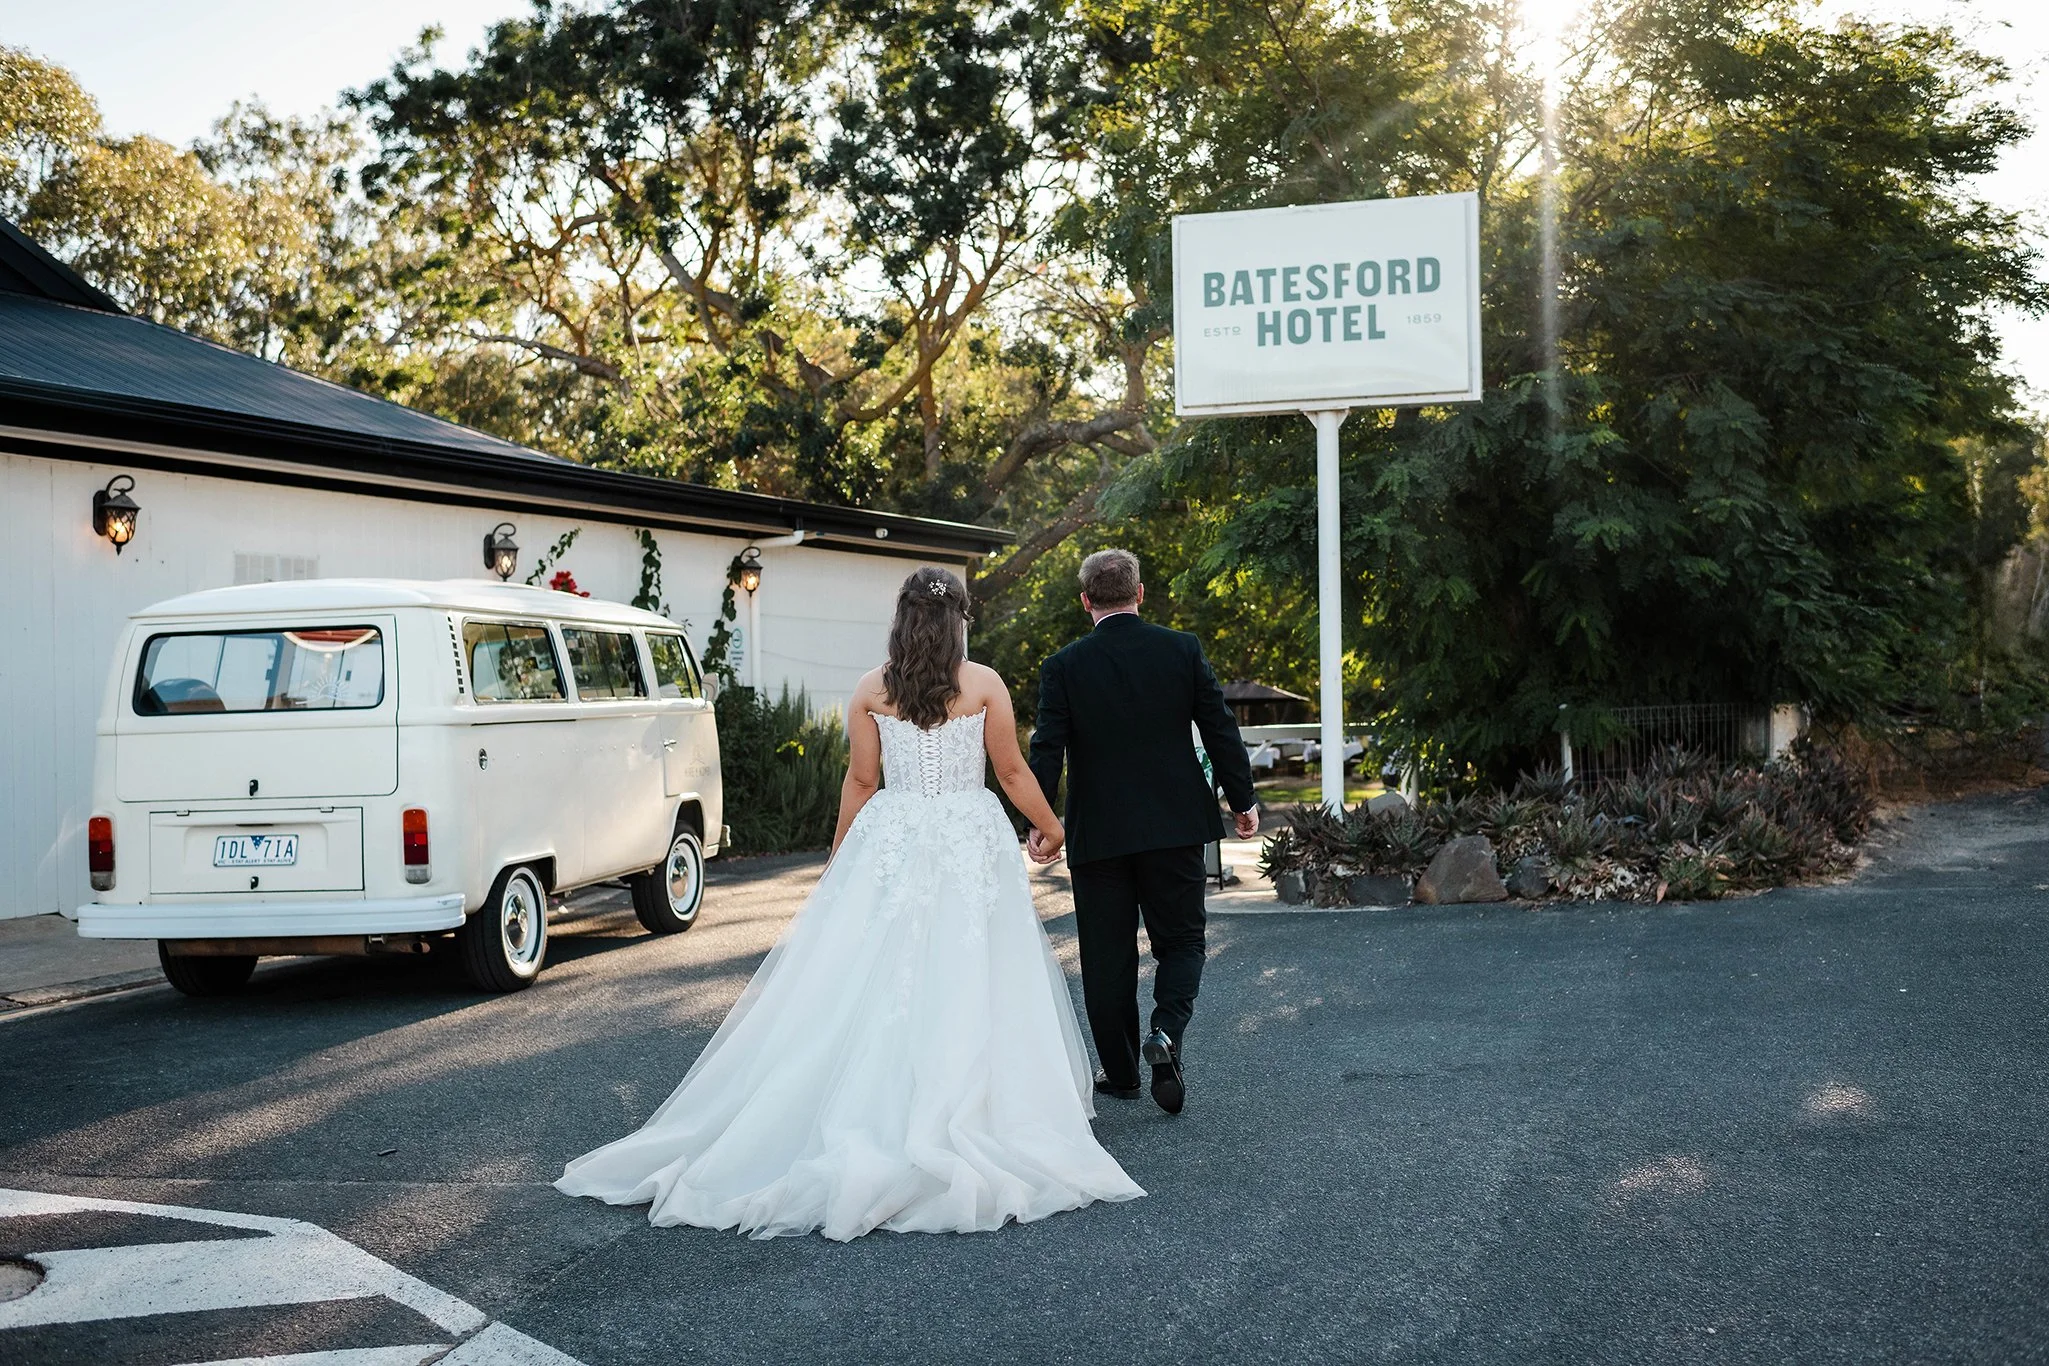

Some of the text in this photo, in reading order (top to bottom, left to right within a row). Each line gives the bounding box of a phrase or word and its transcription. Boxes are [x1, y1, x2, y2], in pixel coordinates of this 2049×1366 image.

[1203, 257, 1441, 308] BATESFORD
[1257, 304, 1386, 347] HOTEL
[1406, 313, 1442, 324] 1859
